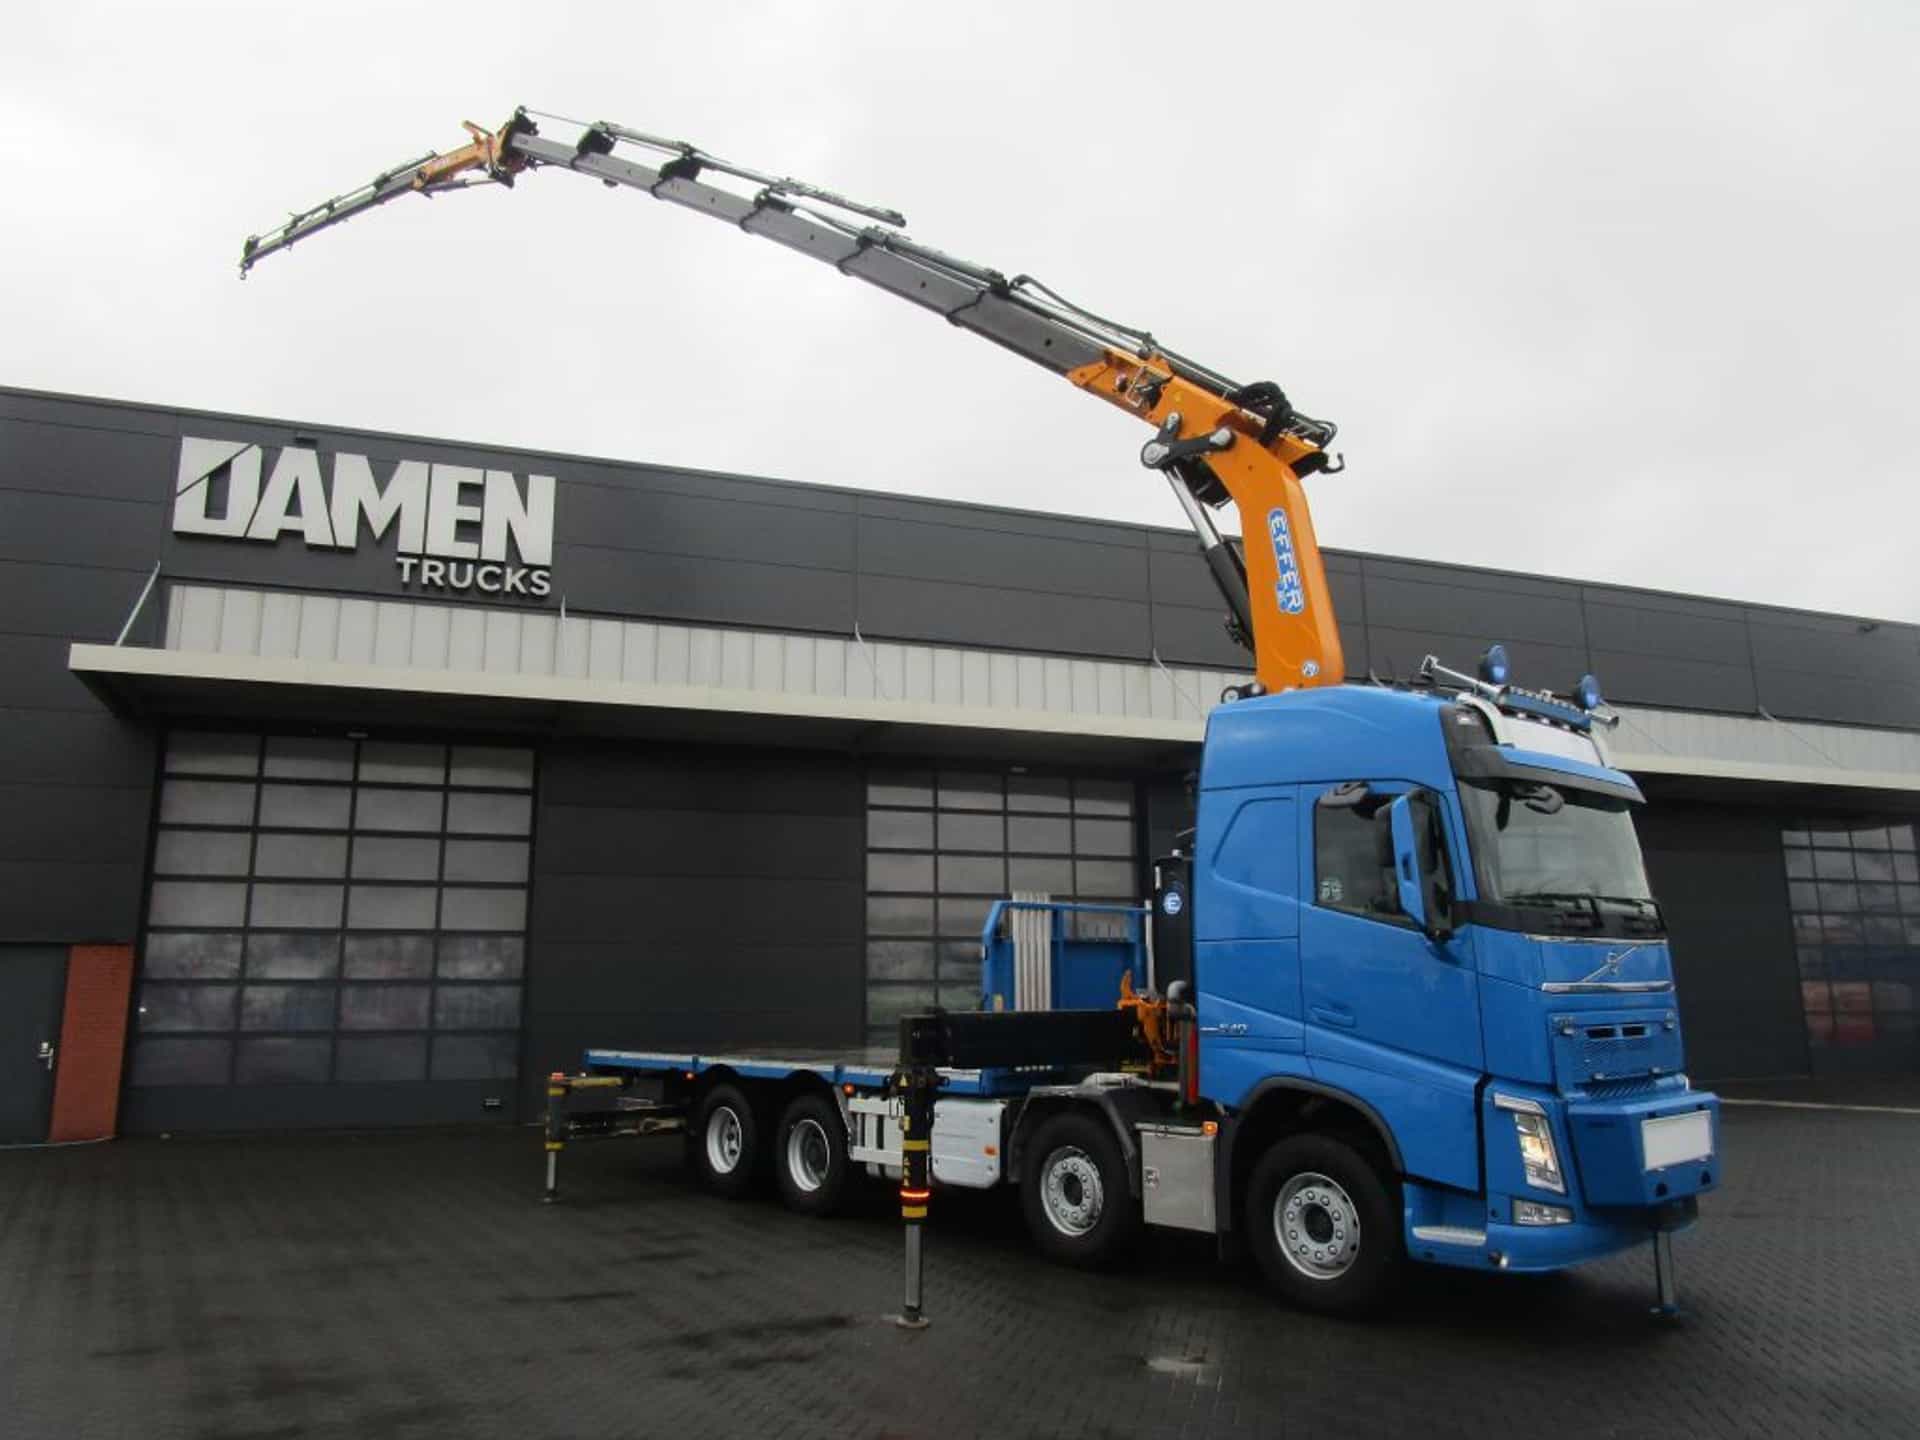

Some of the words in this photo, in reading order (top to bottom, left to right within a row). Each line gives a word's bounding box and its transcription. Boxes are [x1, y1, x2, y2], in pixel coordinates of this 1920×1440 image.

[173, 436, 557, 566] DAMEN
[397, 556, 552, 596] TRUCKS
[1271, 515, 1303, 611] EFFER
